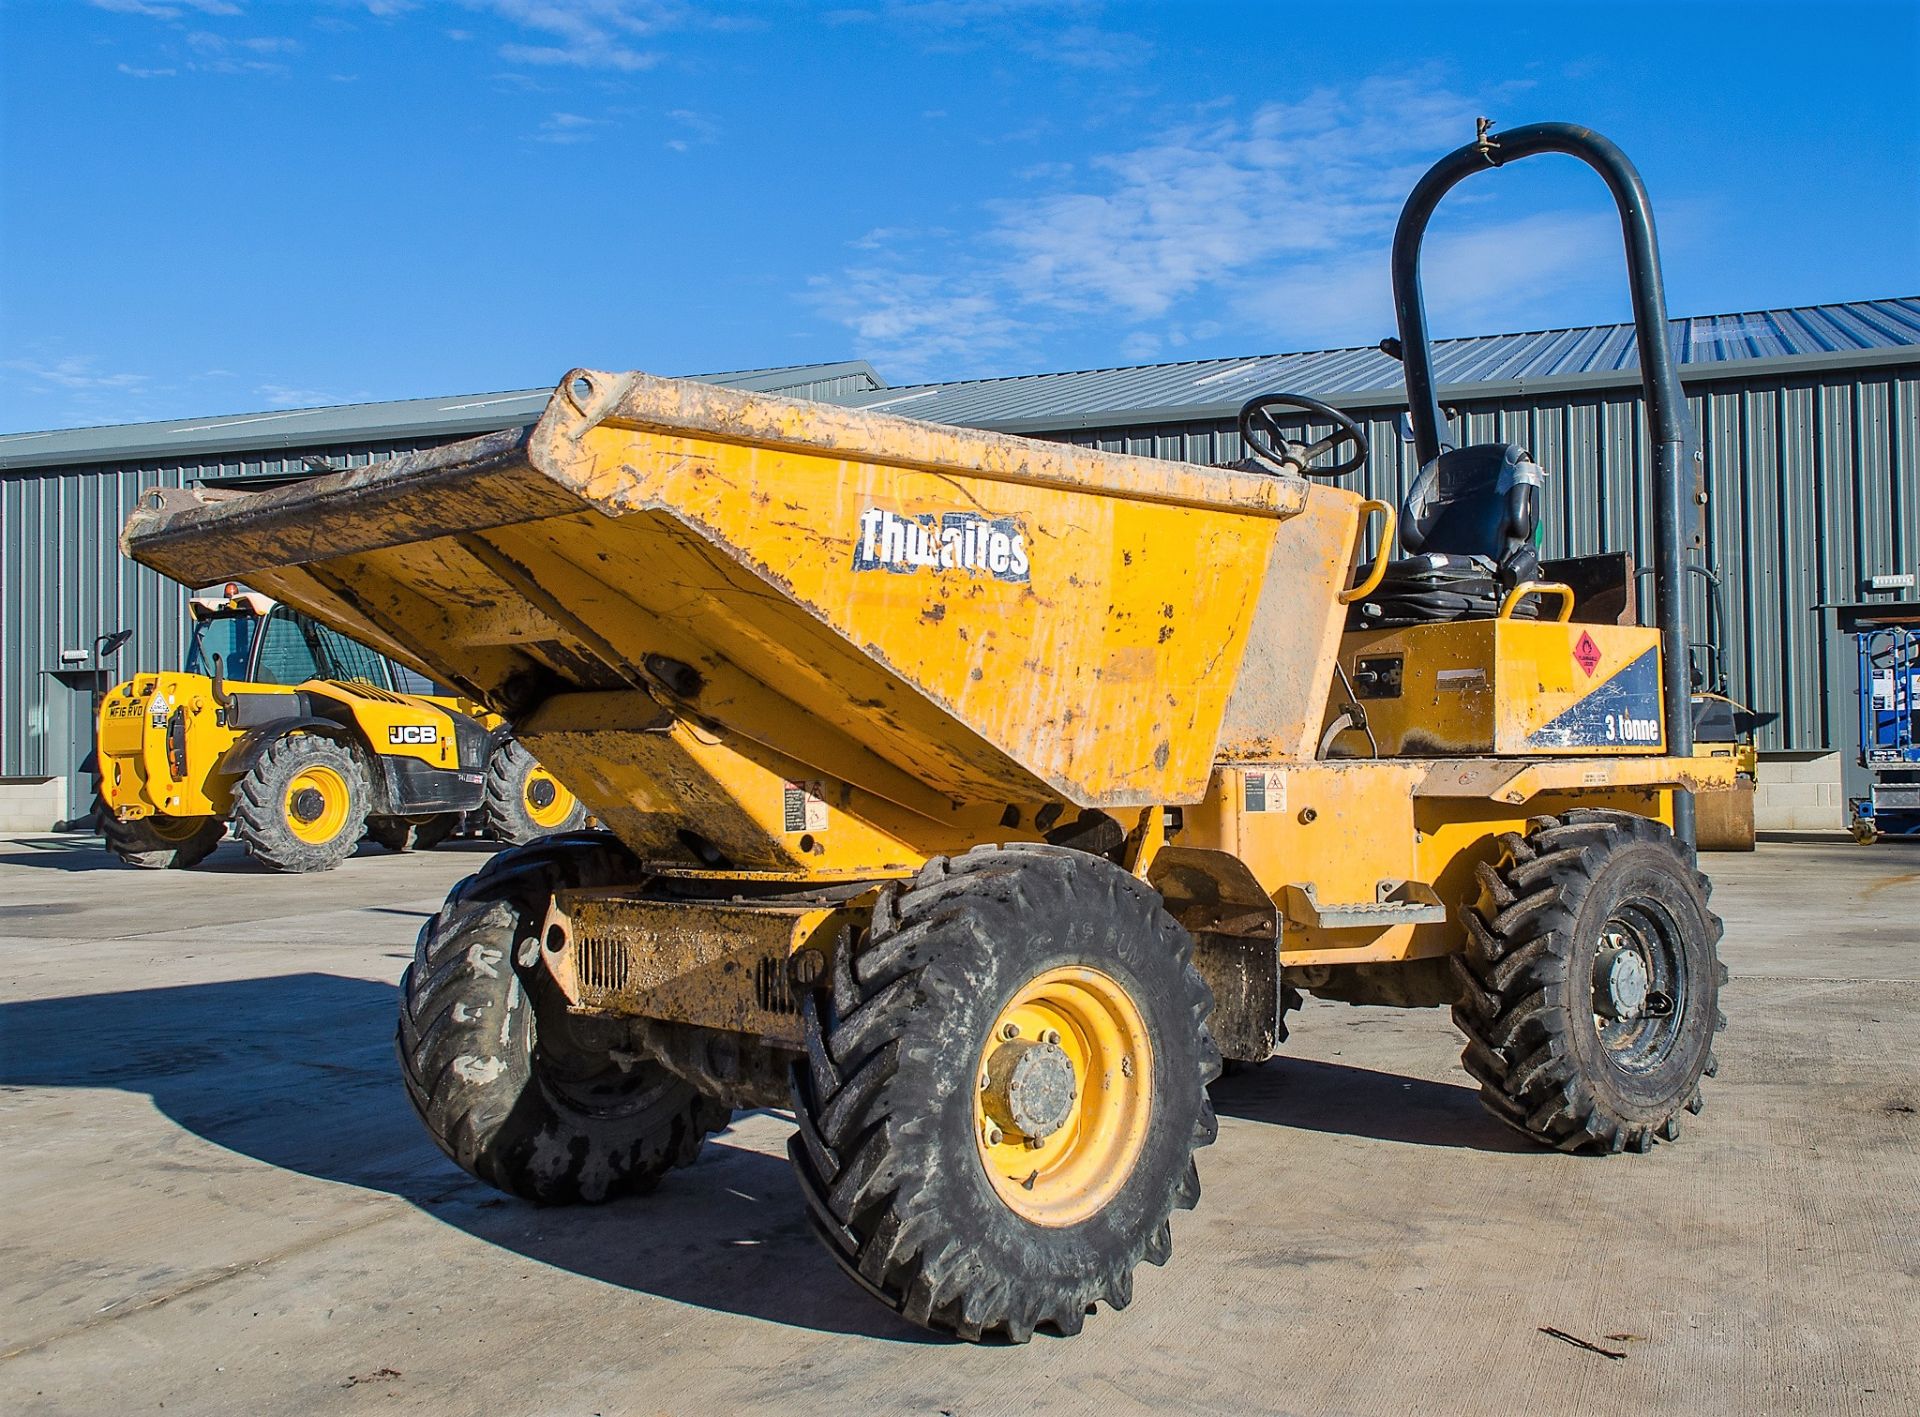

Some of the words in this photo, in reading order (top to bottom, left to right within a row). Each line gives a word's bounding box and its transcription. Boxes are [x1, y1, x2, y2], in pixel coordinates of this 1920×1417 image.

[389, 726, 436, 743] JCB
[1605, 714, 1615, 741] 3
[1618, 714, 1658, 741] tonne
